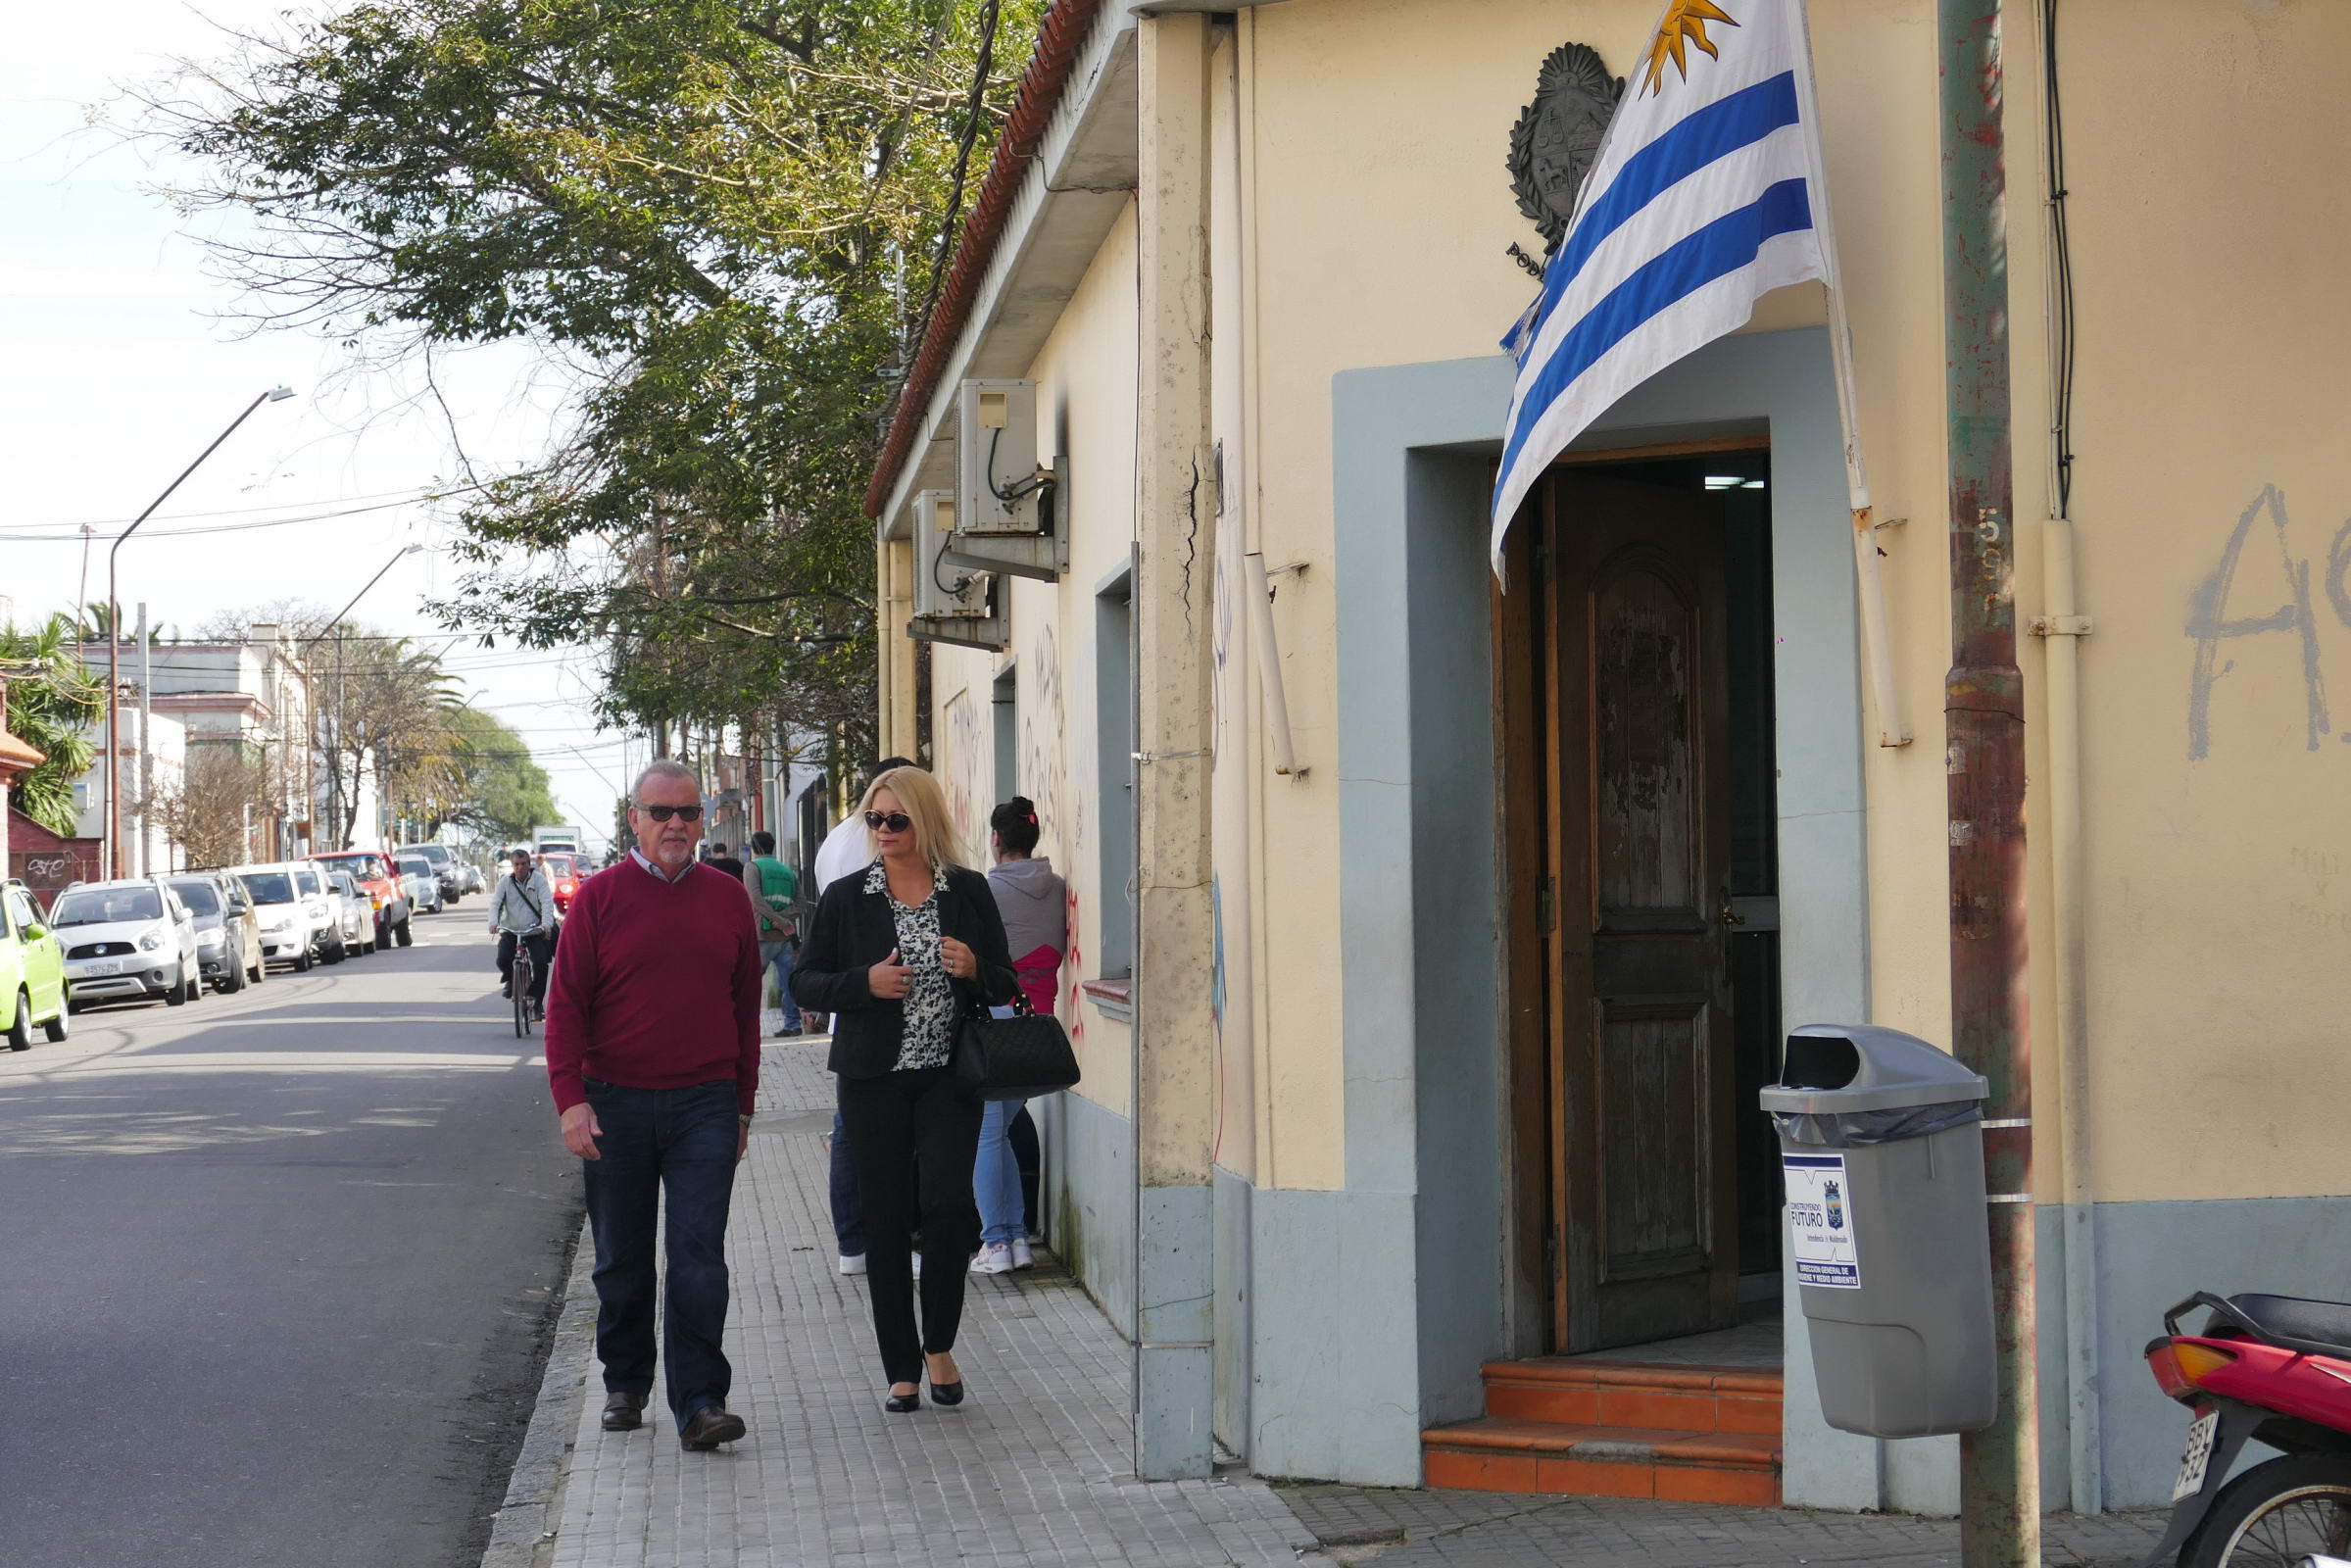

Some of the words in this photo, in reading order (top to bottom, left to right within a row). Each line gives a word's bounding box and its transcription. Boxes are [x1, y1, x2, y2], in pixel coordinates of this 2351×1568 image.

[1791, 1211, 1823, 1228] FUTURO
[1821, 1265, 1841, 1275] GENERAL
[1841, 1266, 1848, 1275] DE
[1831, 1275, 1857, 1285] AMBIENTE
